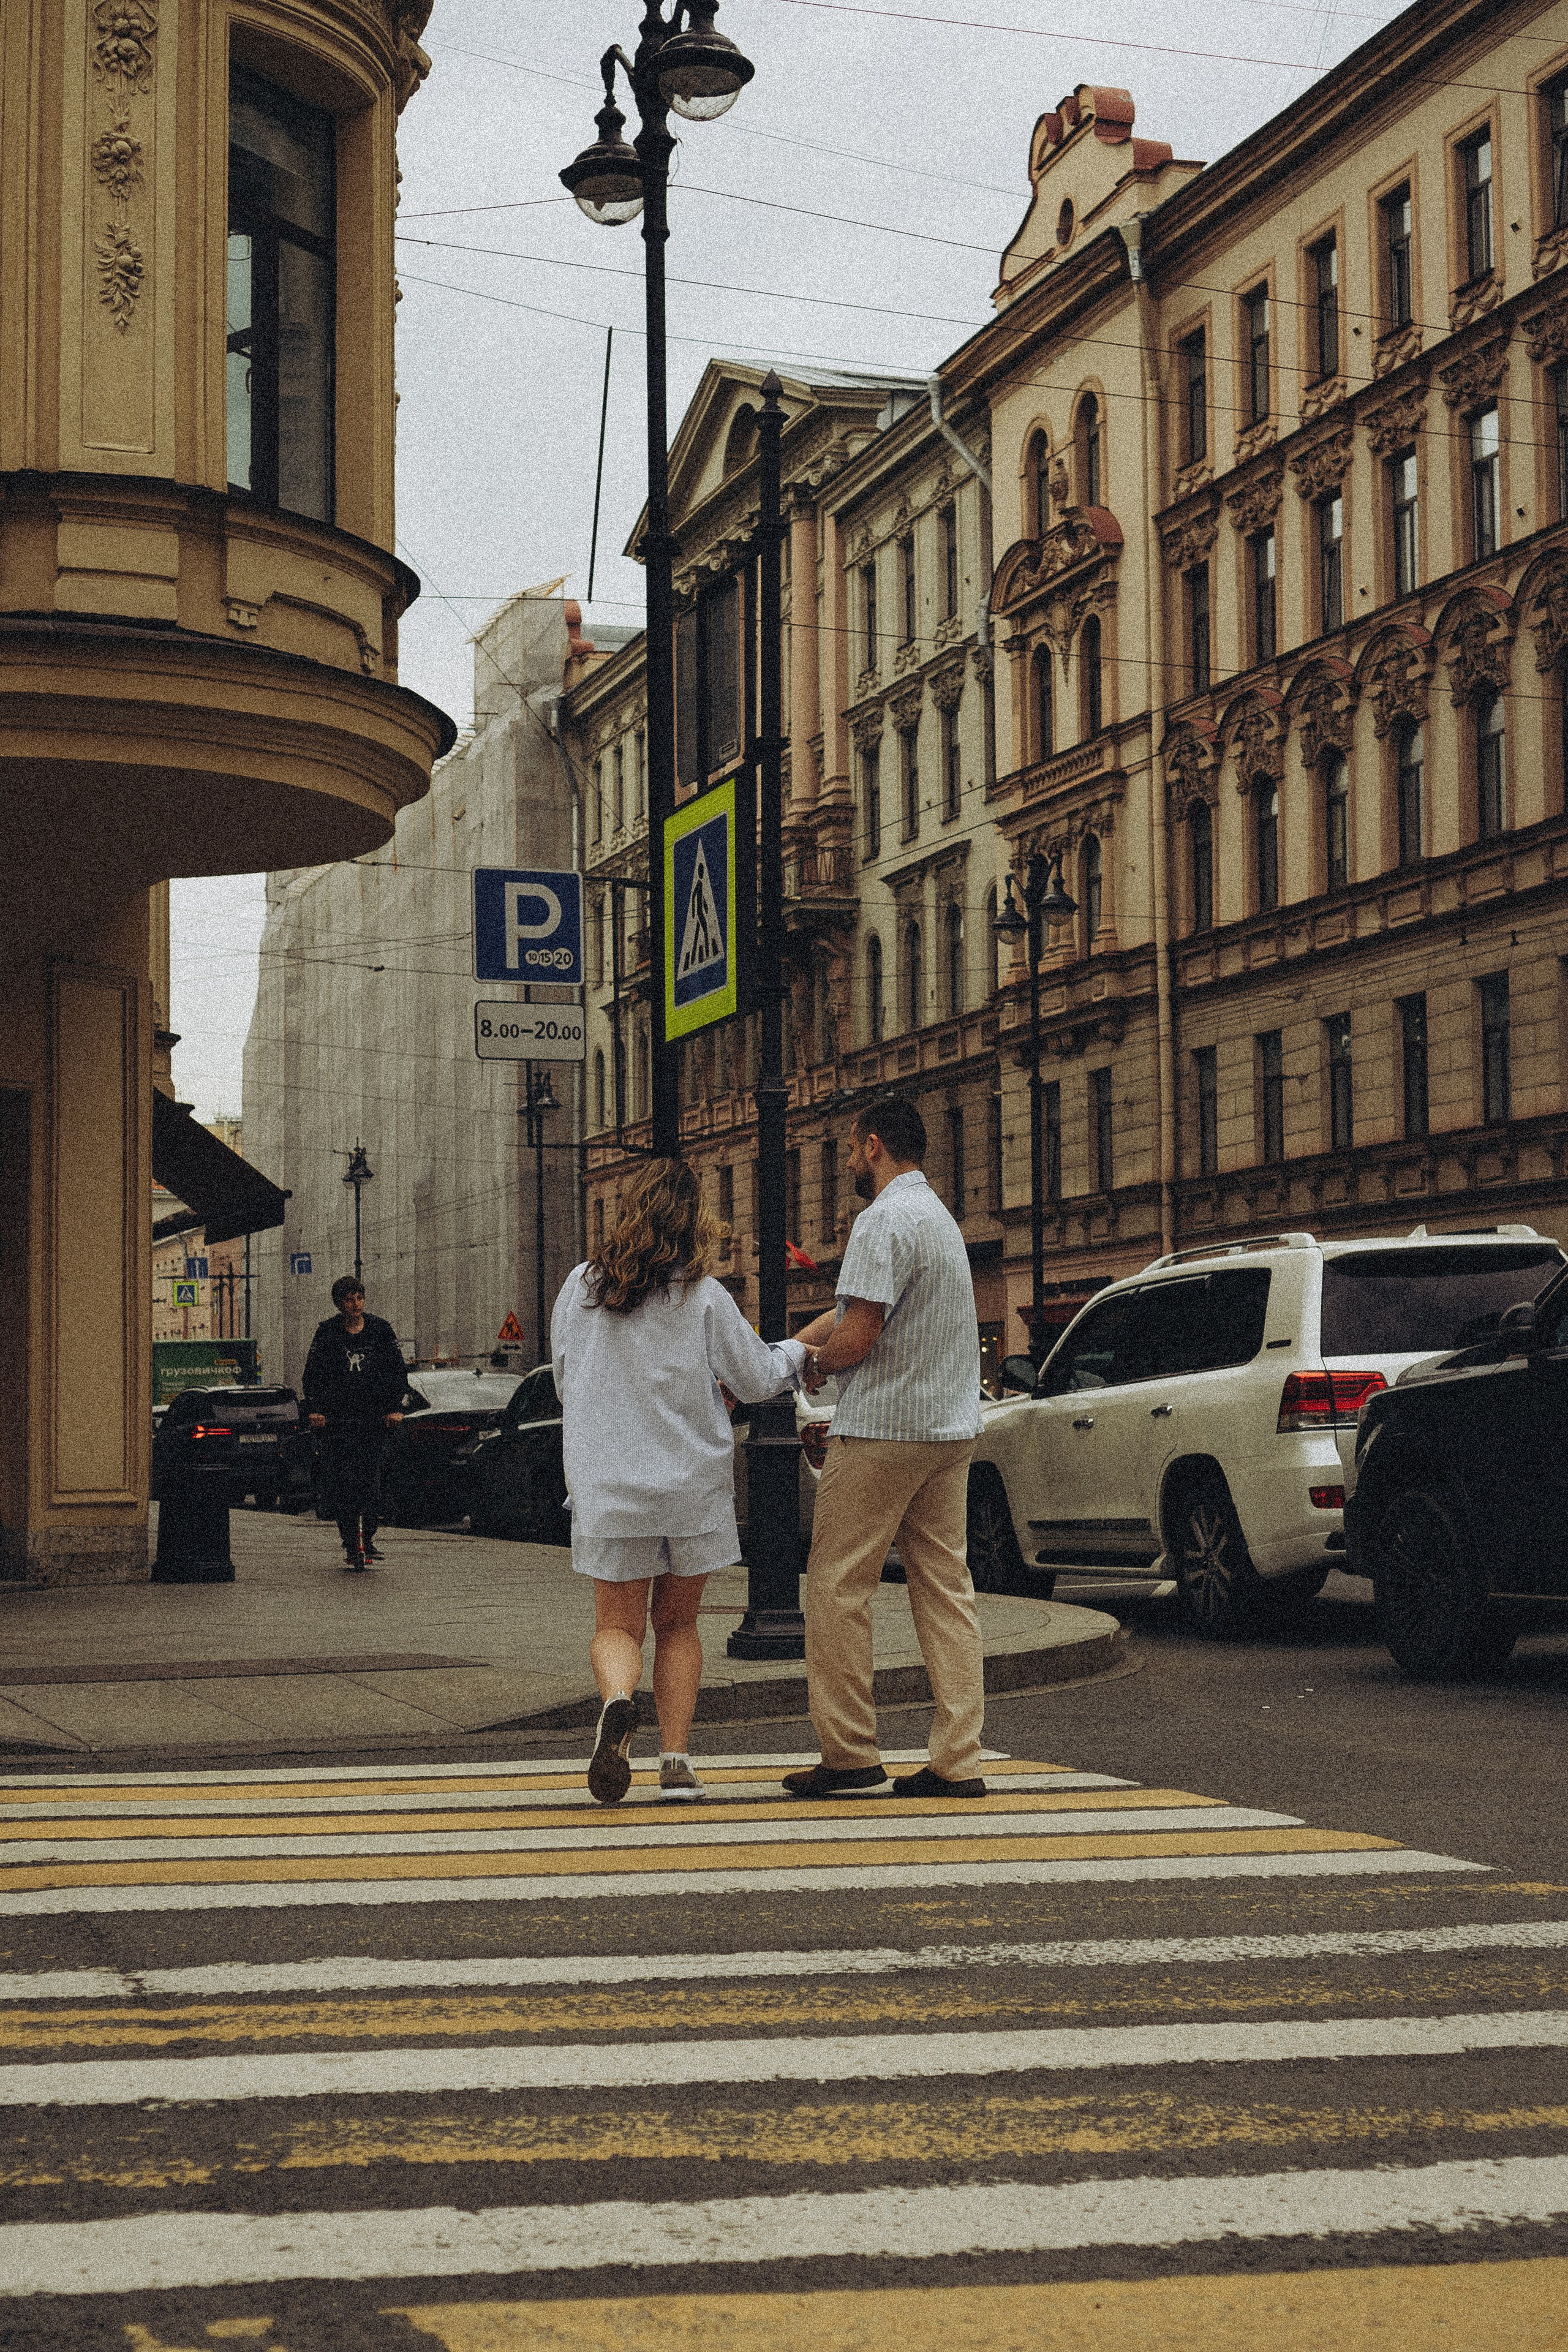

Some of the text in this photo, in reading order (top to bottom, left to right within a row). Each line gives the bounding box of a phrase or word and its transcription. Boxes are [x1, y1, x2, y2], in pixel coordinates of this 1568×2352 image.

[505, 882, 562, 969] P
[528, 952, 572, 965] 10 15 20
[160, 1366, 243, 1377] грузовичкоф
